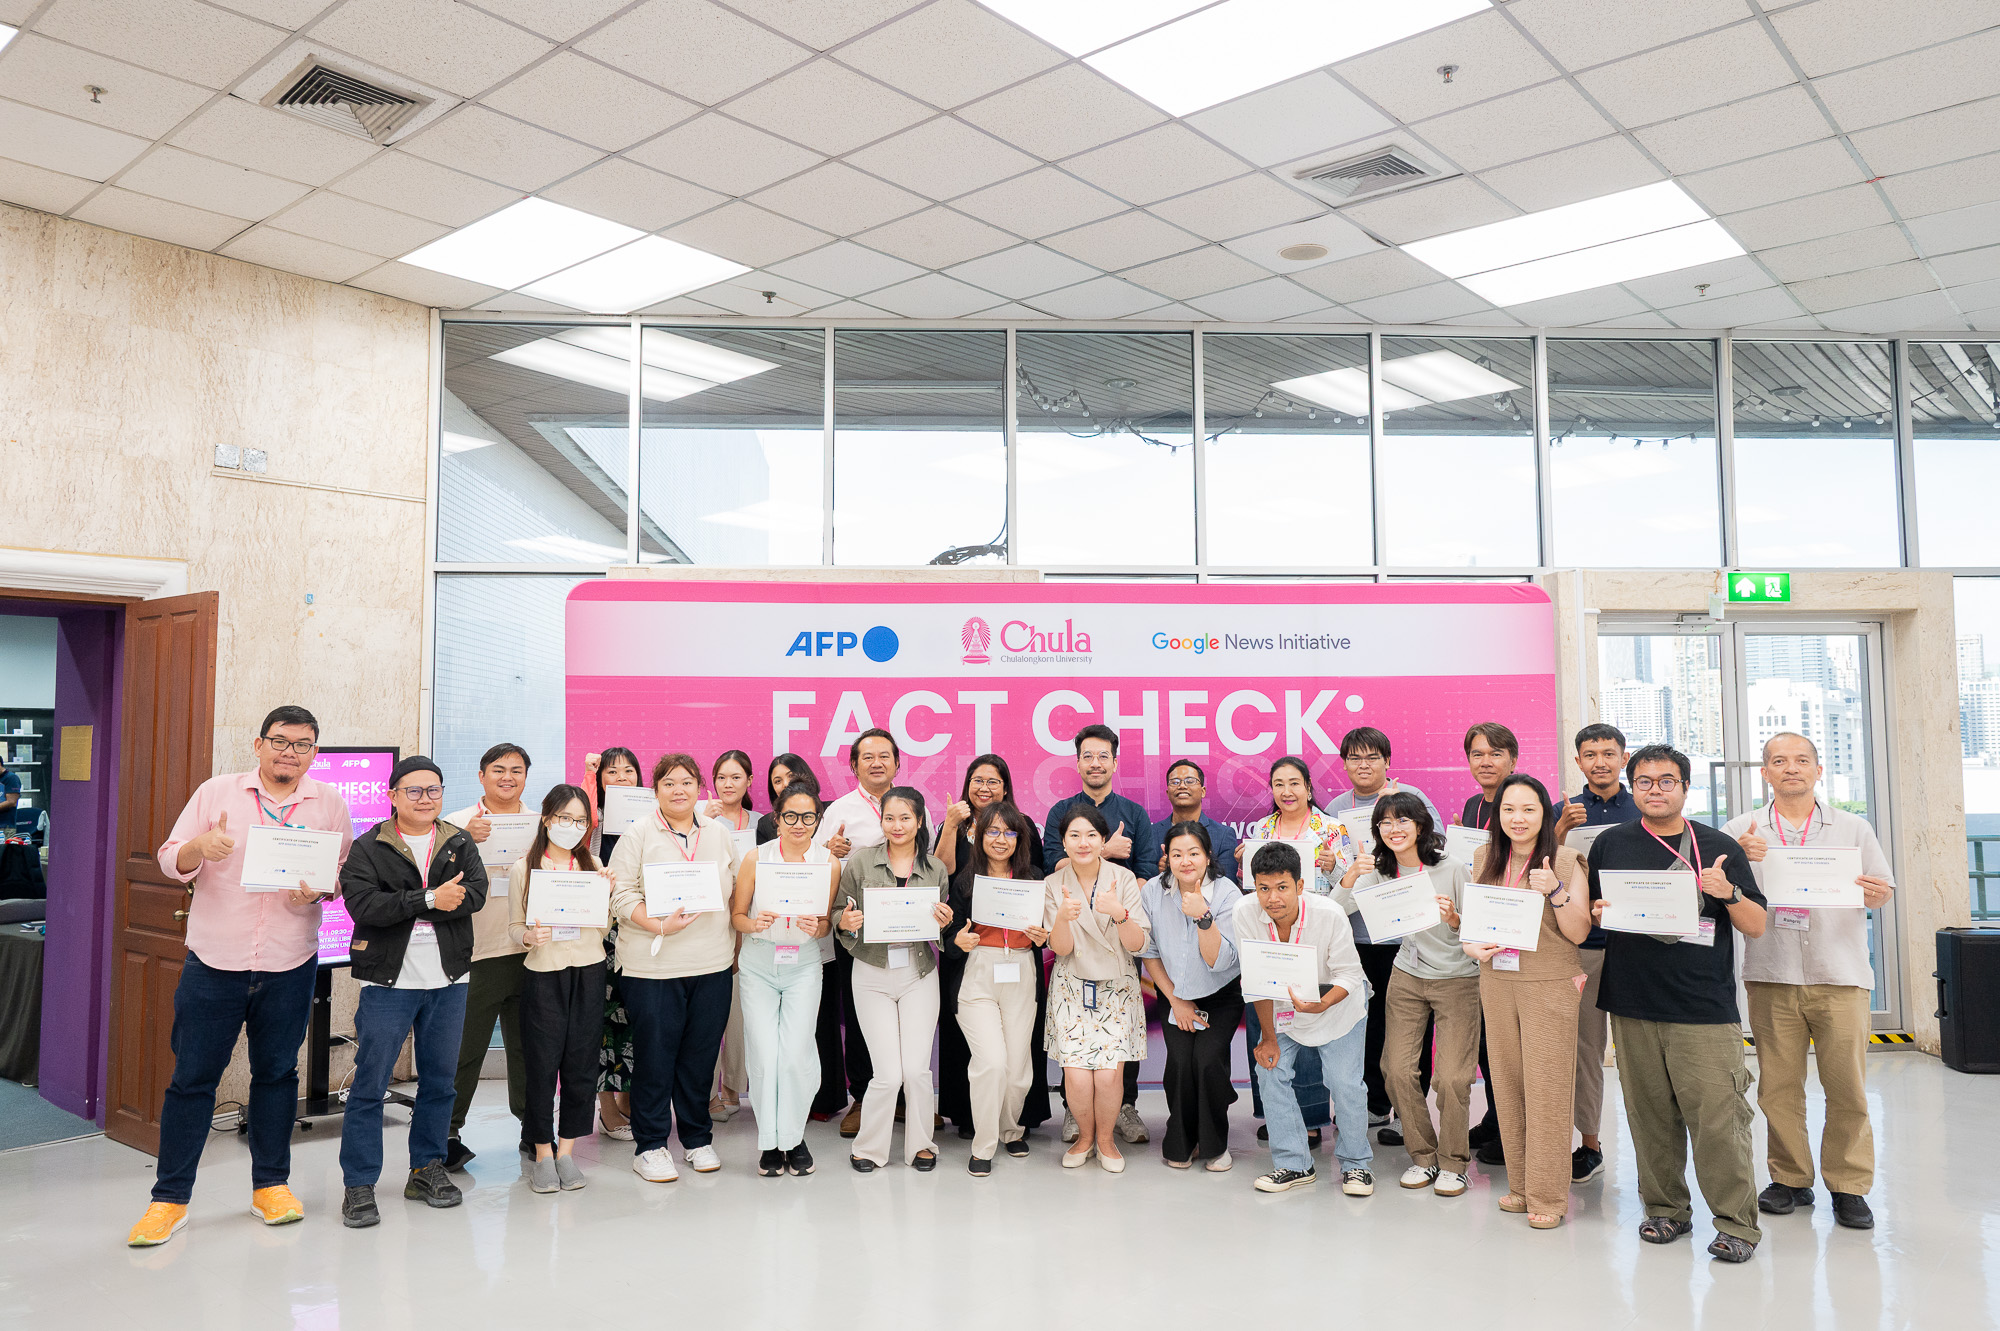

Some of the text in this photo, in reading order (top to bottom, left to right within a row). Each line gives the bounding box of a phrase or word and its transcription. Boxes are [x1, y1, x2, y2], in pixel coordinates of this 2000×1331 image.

[786, 631, 858, 657] AFP
[1000, 618, 1092, 653] Chula
[1152, 632, 1351, 655] Google News Initiative
[1000, 655, 1093, 665] Chulalongkorn University
[772, 690, 1009, 757] FACT
[341, 760, 360, 768] AFP
